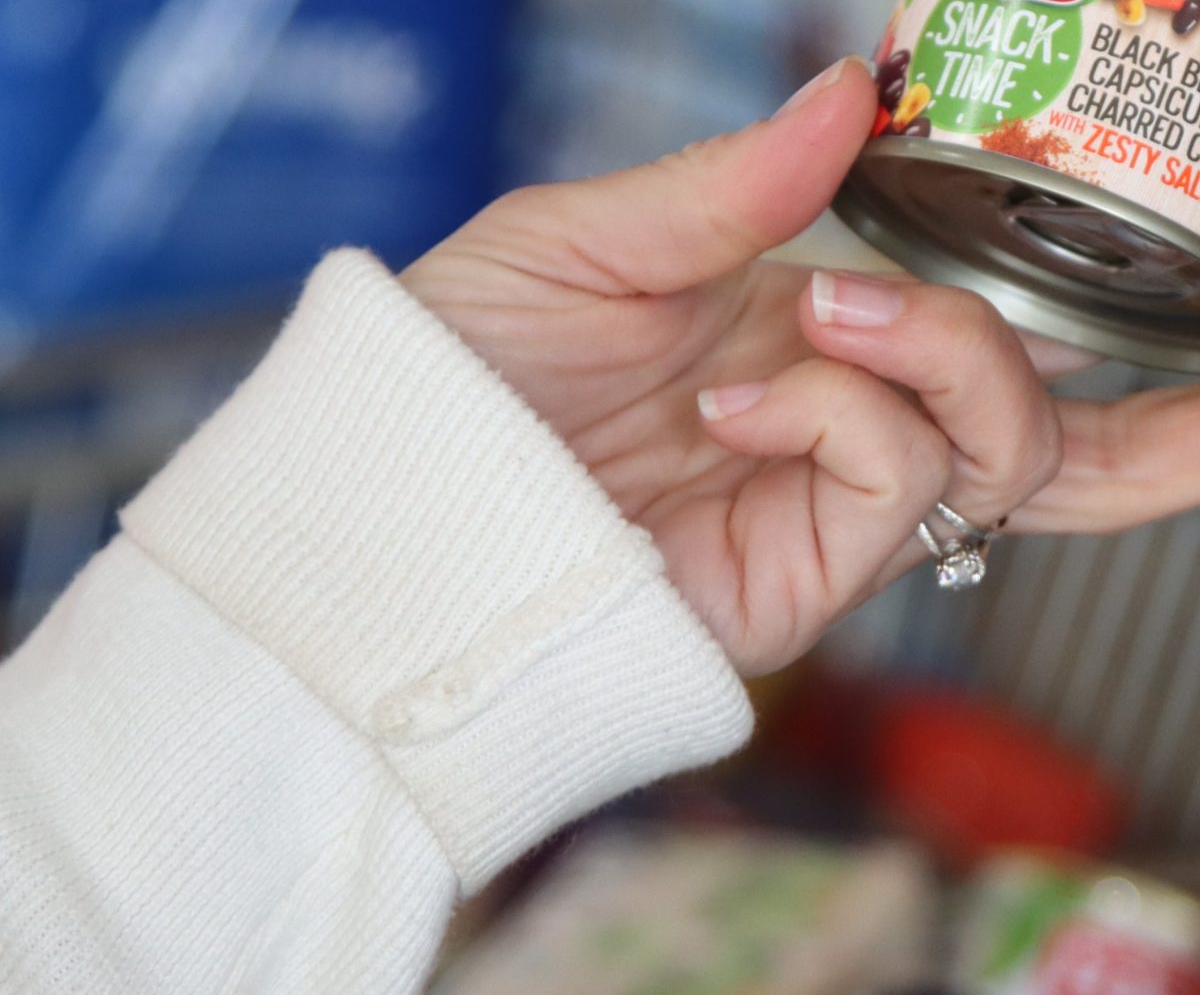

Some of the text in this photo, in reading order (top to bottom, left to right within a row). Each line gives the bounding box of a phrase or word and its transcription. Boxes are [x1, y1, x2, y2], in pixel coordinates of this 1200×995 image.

[934, 0, 1066, 63] SNACK
[1091, 23, 1180, 79] BLACK
[935, 51, 1027, 108] TIME
[1048, 110, 1086, 135] WITH
[1082, 124, 1162, 176] ZESTY
[1067, 83, 1185, 151] CHARRED
